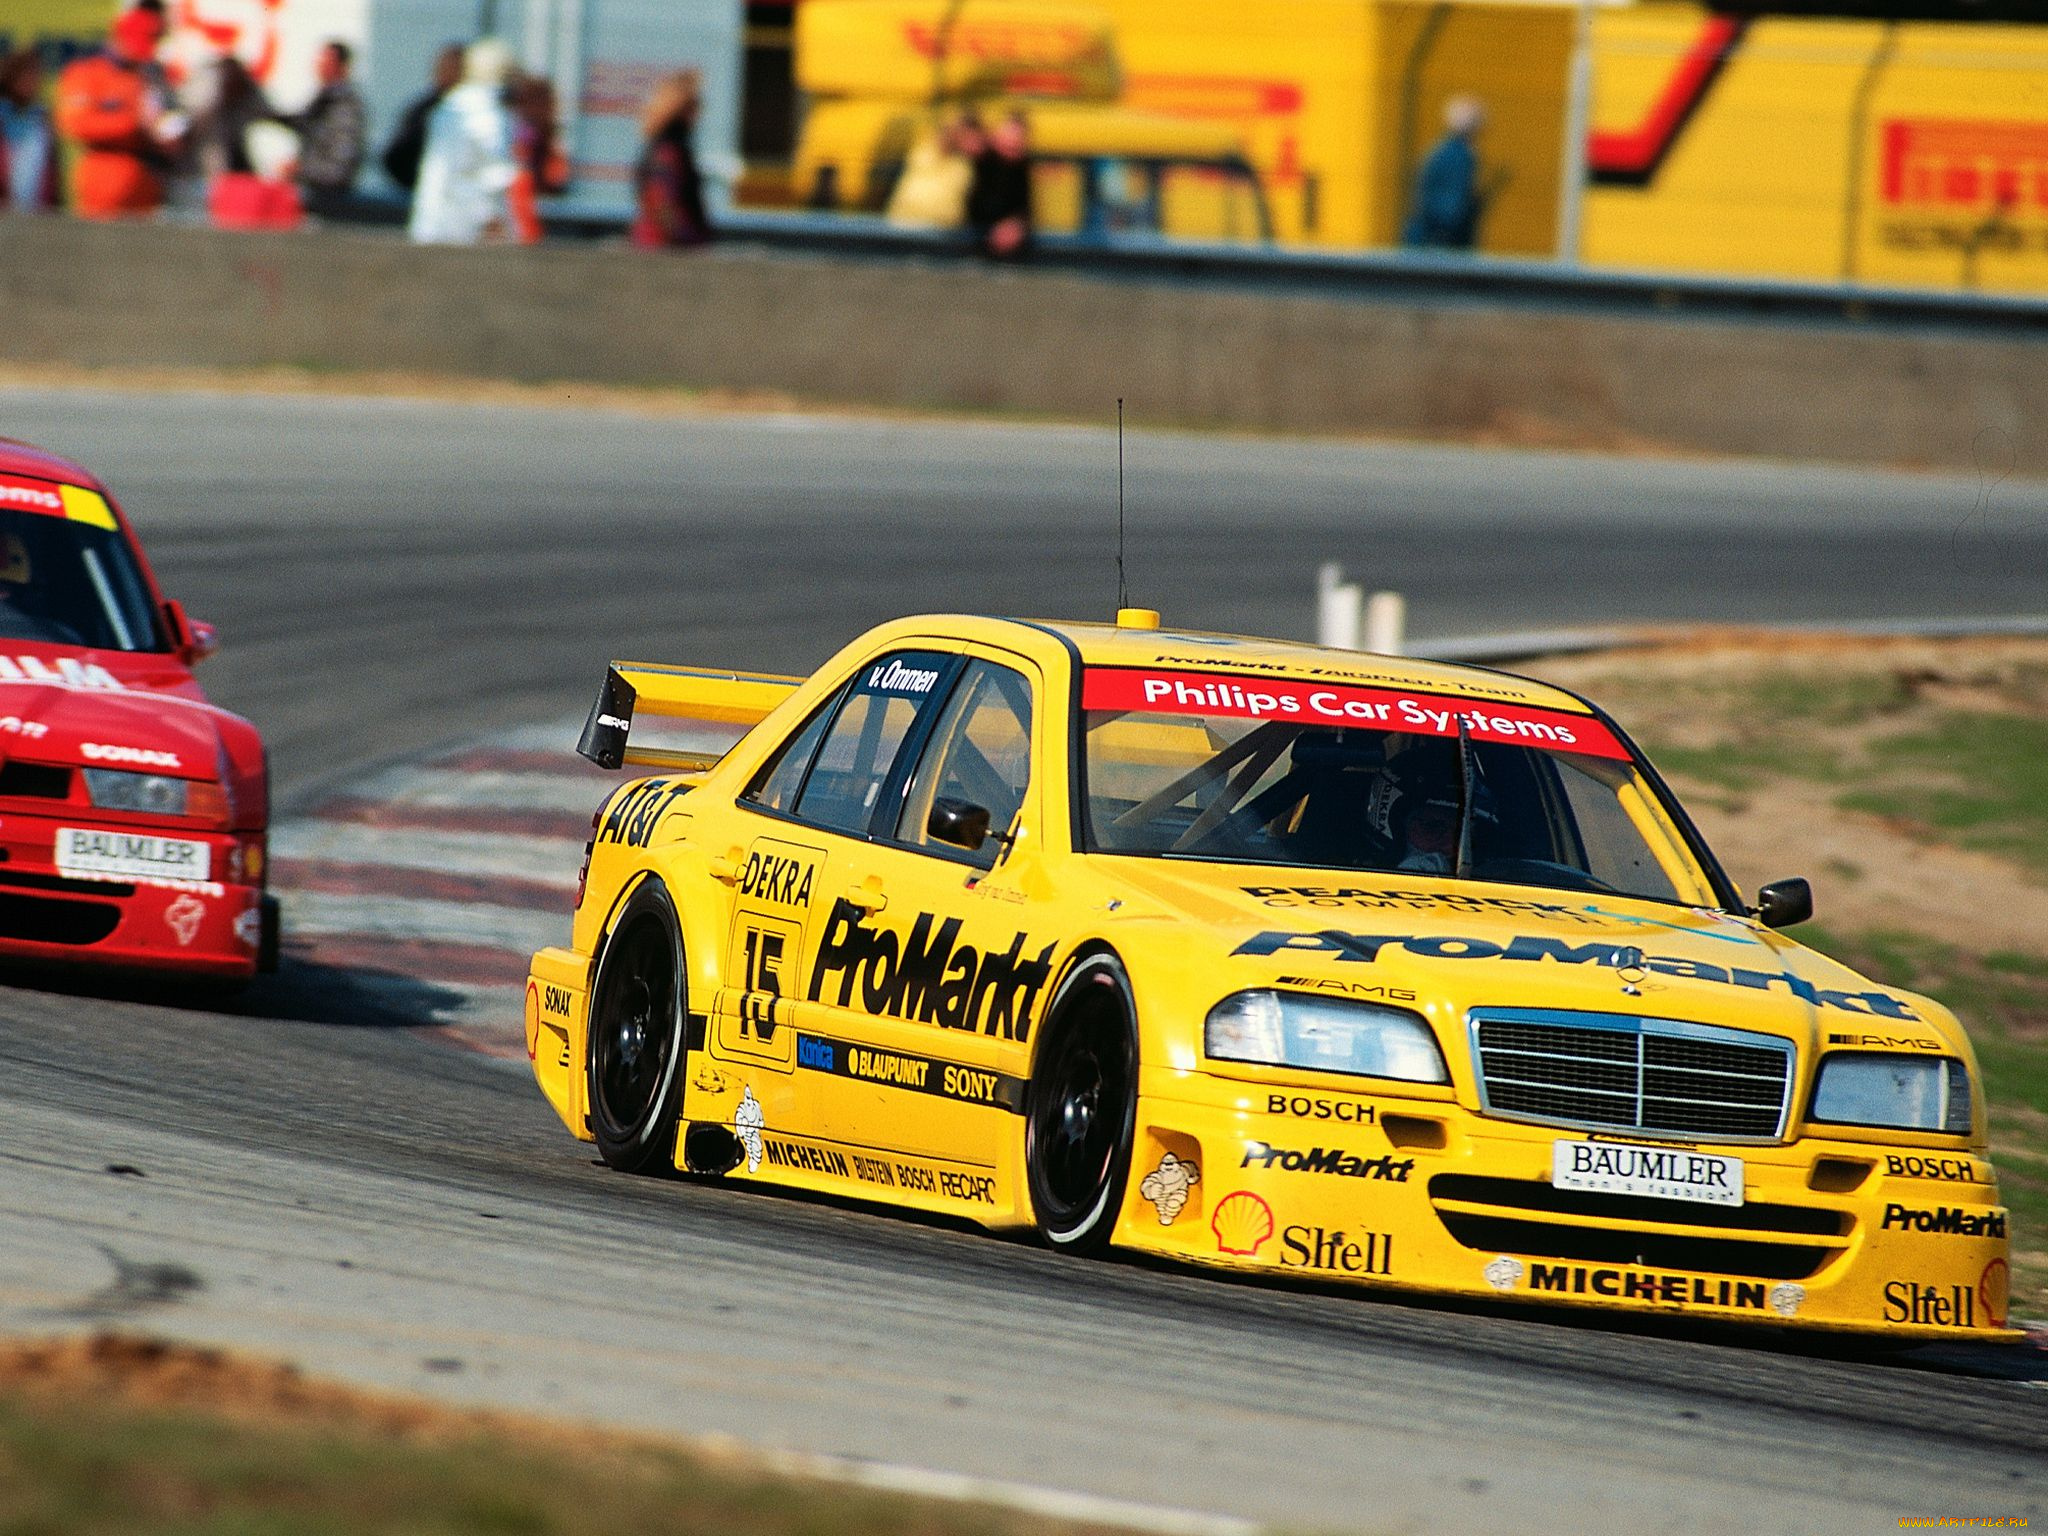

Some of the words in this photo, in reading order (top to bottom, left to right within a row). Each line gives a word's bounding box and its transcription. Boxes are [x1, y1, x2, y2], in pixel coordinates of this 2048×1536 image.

[1155, 656, 1287, 671] ProMarkt
[1452, 682, 1526, 699] Team
[1144, 679, 1301, 715] Philips
[1309, 692, 1391, 720] Car
[1398, 699, 1577, 743] Systems
[598, 780, 698, 848] AT&T
[741, 852, 814, 907] DEKRA
[1240, 886, 1577, 925] PEACOCK
[739, 926, 787, 1043] 15
[807, 896, 1061, 1043] ProMarkt
[1228, 928, 1922, 1022] ProMarkt
[545, 985, 572, 1017] SONAX
[1316, 979, 1417, 1001] AMG
[1861, 1035, 1942, 1050] AMG
[858, 1059, 928, 1087] BLAUPUNKT
[943, 1066, 998, 1101] SONY
[1268, 1094, 1375, 1124] BOSCH
[765, 1140, 849, 1177] MICHELIN
[853, 1155, 893, 1186] BILSTEIN
[898, 1164, 935, 1193] BOSCH
[1239, 1141, 1415, 1182] ProMarkt
[1885, 1155, 1974, 1181] BOSCH
[1280, 1224, 1393, 1275] Shell
[1529, 1263, 1766, 1309] MICHELIN
[1883, 1281, 1976, 1328] Shell
